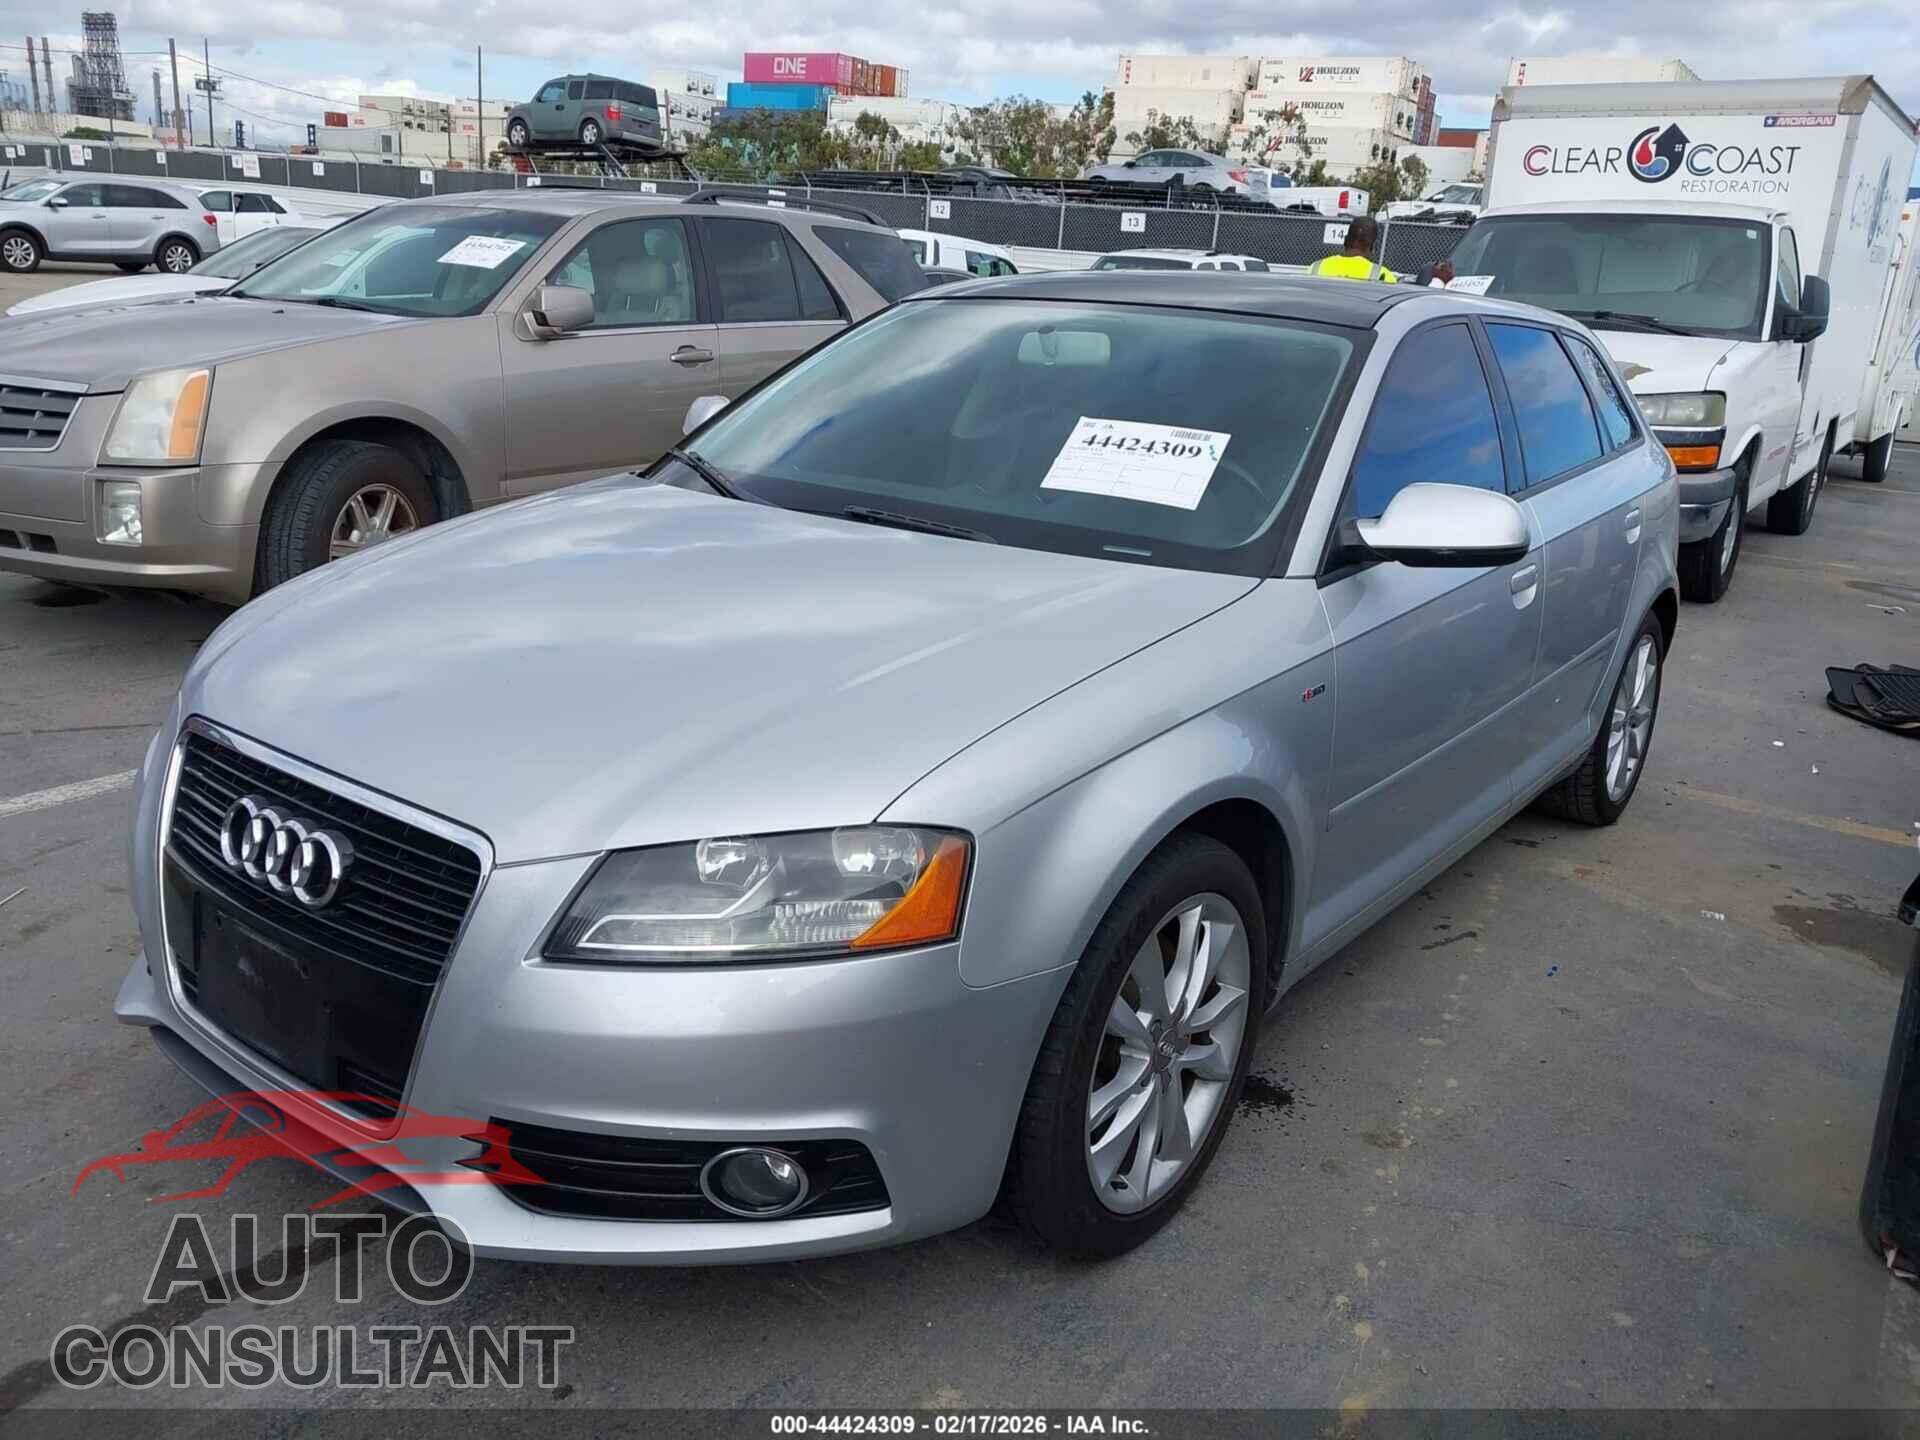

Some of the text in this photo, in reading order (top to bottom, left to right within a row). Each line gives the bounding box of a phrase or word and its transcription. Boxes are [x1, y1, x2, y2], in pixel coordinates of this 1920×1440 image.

[773, 57, 808, 74] ONE
[1316, 66, 1361, 75] HORIZON
[1301, 101, 1344, 110] HORIZON
[1776, 116, 1834, 126] MORGAN
[1285, 135, 1329, 145] HOZON
[1523, 143, 1801, 176] CLEAR COAST
[1680, 179, 1790, 194] RESTORATION
[935, 204, 946, 215] 12
[1127, 217, 1140, 229] 13
[1331, 229, 1344, 240] 14
[1082, 433, 1203, 459] 44424309
